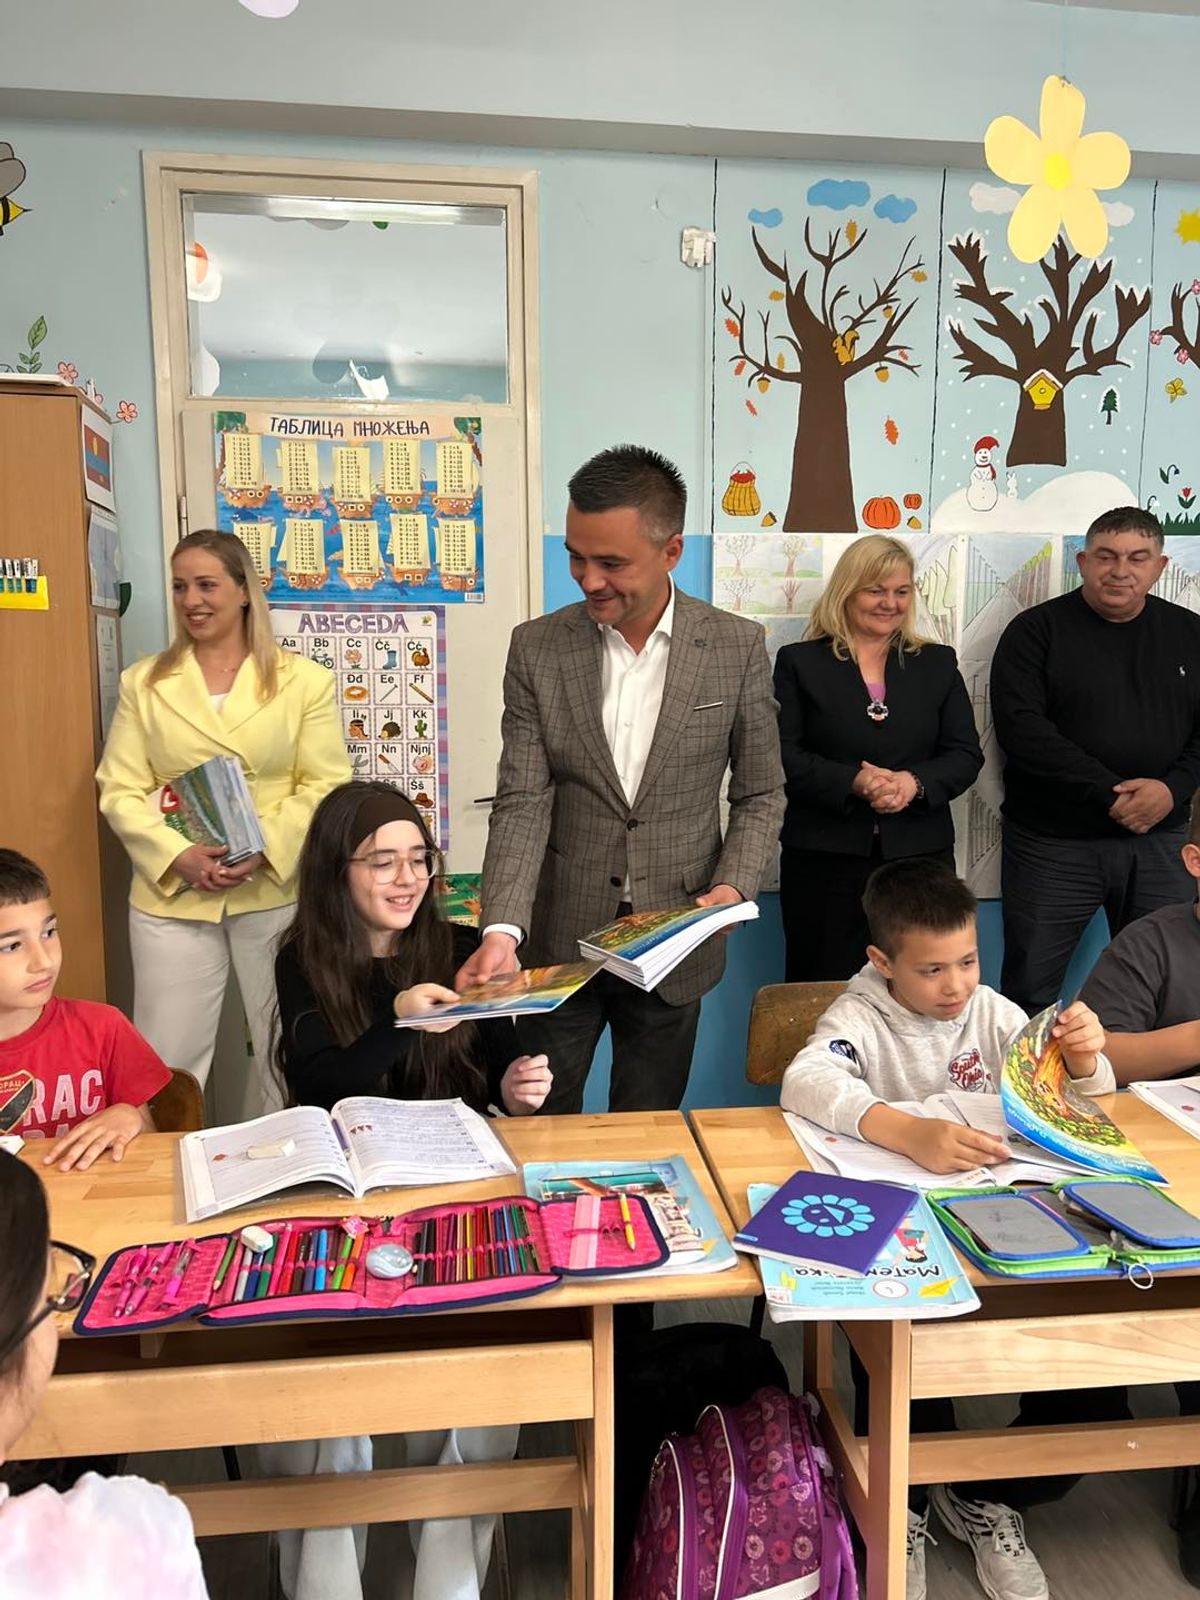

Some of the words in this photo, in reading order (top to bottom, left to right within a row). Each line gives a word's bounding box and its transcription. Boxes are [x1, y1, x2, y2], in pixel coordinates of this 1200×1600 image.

[270, 416, 344, 439] ТАБЛИЦА
[353, 419, 430, 437] МНОЖЕЊА
[297, 613, 410, 634] ABECEDA
[281, 637, 297, 648] Aa
[313, 637, 329, 648] Bb
[346, 637, 362, 648] Cc
[375, 638, 390, 651] Čč
[407, 638, 423, 651] Ćć
[347, 674, 363, 684] Đđ
[380, 674, 395, 684] Ee
[413, 674, 424, 684] Ff
[352, 709, 360, 719] Ii
[383, 709, 394, 721] Jj
[412, 709, 428, 719] Kk
[347, 744, 367, 754] Mm
[381, 744, 397, 754] Nn
[410, 744, 431, 755] Njnj
[410, 777, 425, 790] Šš
